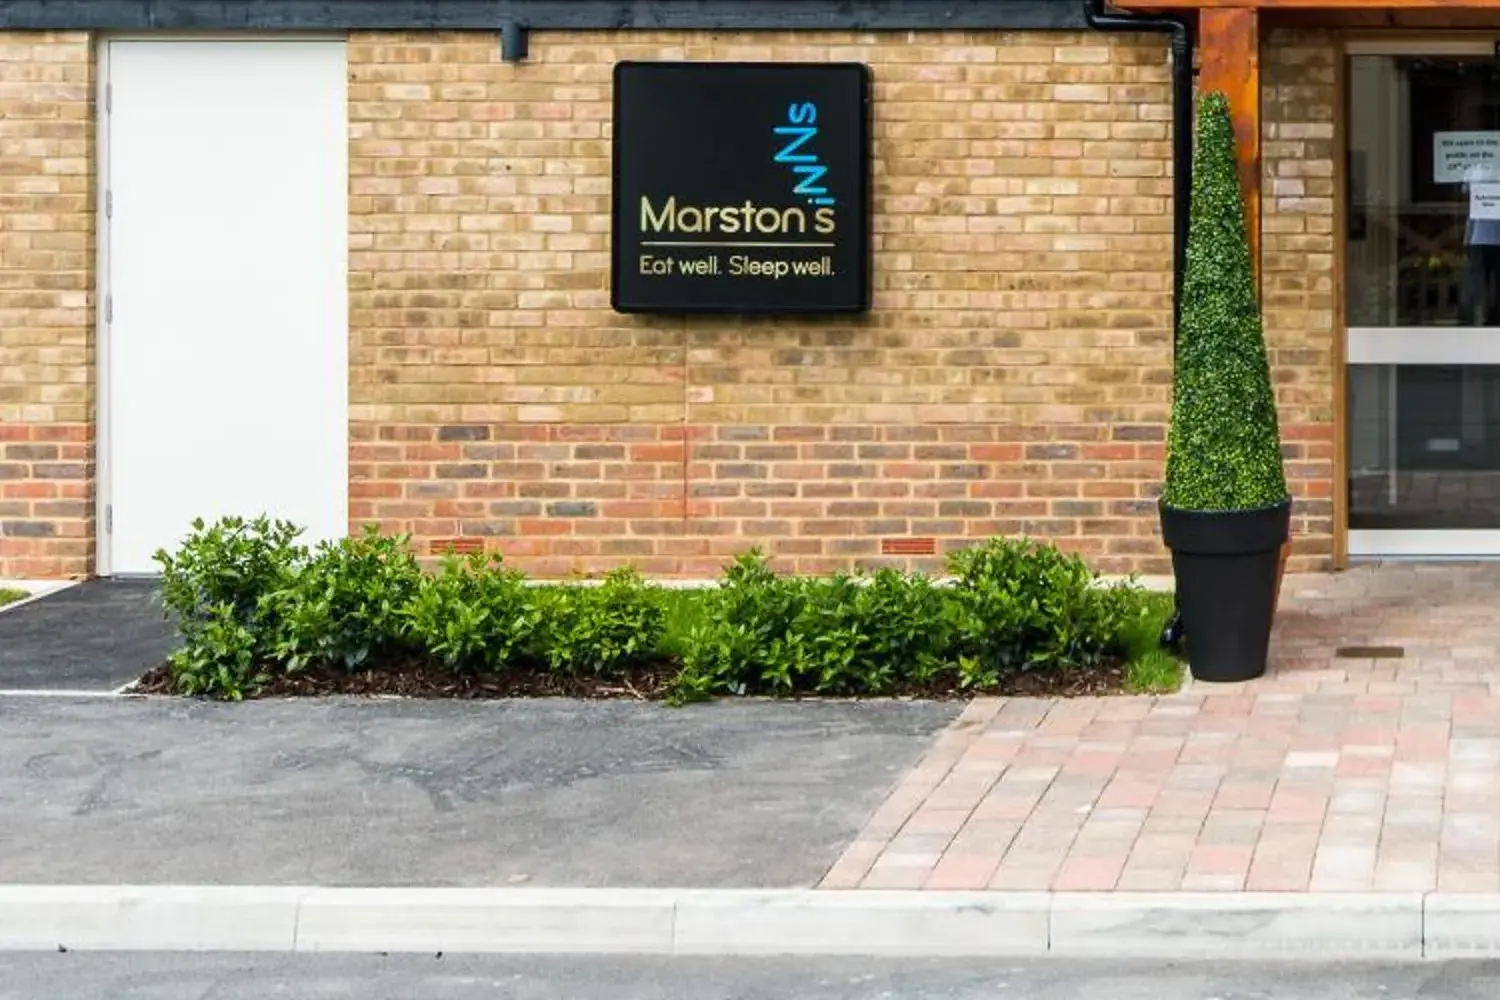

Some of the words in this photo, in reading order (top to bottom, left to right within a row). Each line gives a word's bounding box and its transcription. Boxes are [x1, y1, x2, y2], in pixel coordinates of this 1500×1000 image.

[639, 255, 674, 275] Eat
[678, 256, 723, 276] well.
[728, 256, 789, 279] Sleep
[791, 256, 836, 276] well.
